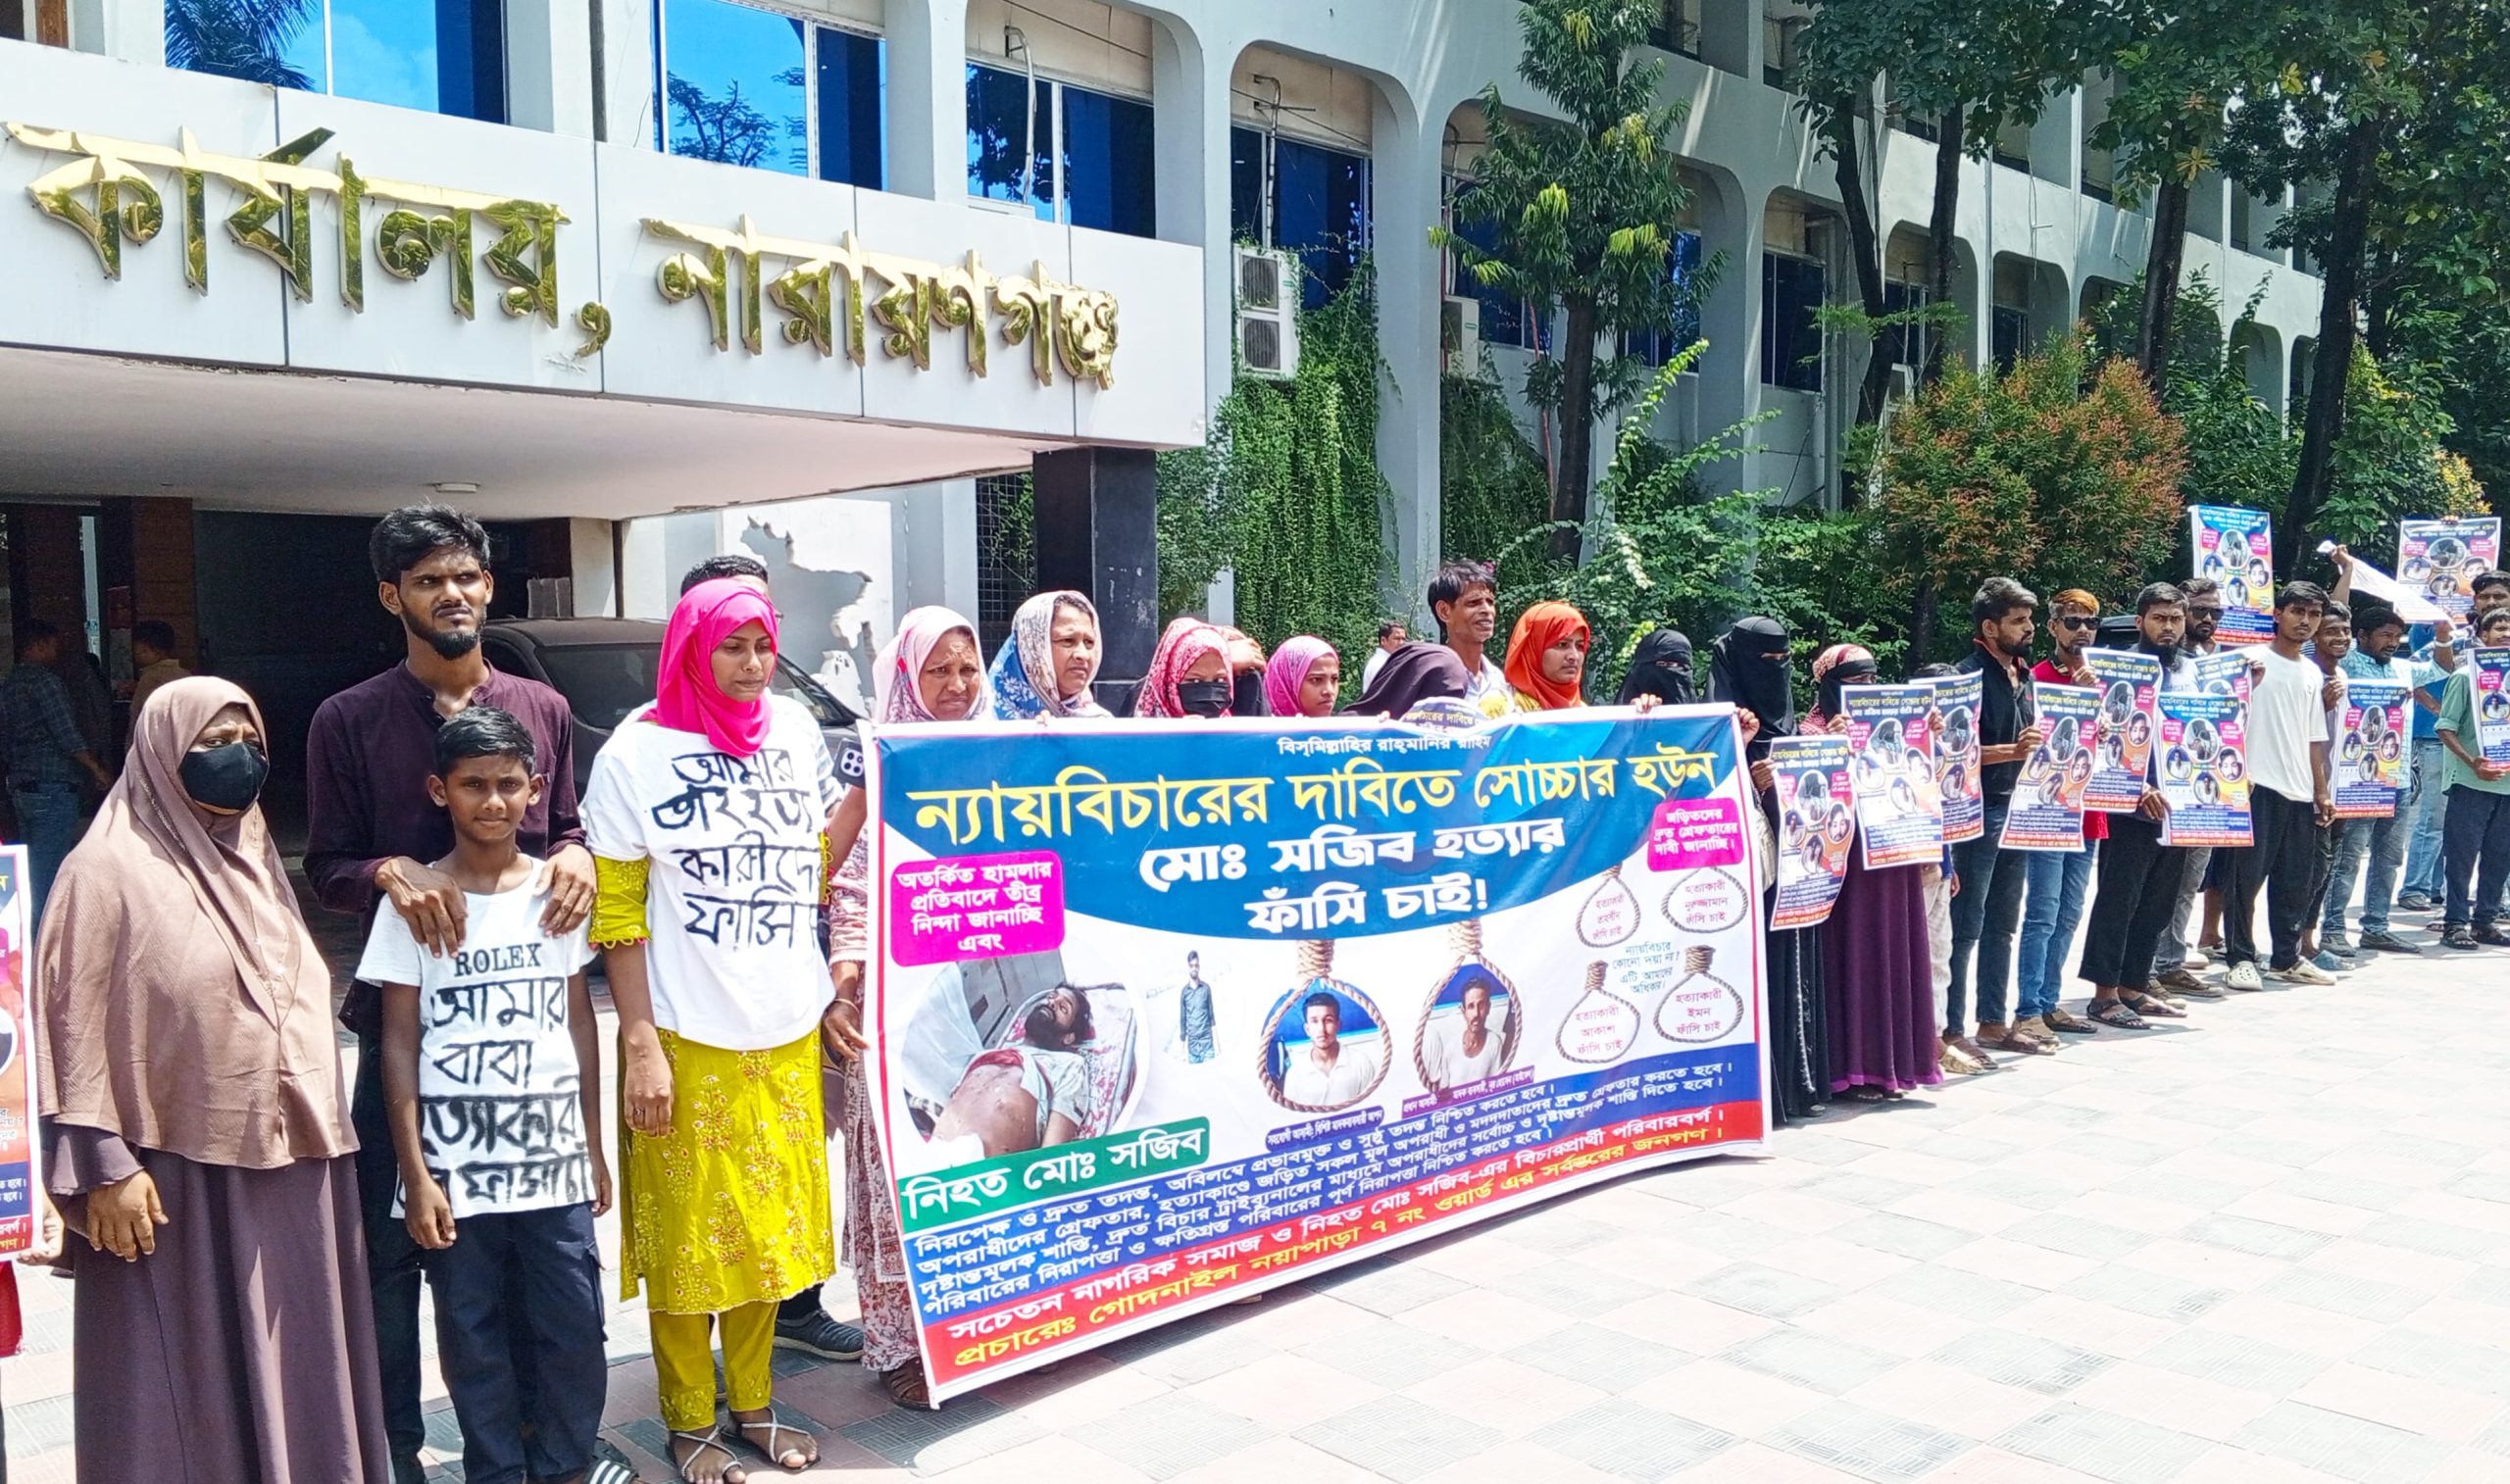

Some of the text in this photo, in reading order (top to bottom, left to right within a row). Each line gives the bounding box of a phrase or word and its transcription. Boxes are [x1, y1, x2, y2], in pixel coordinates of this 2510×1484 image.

[639, 213, 1119, 391] নারায়ণগঞ্জ
[907, 766, 1274, 846] ন্যায়বিচারের
[1286, 757, 1462, 819] দাবিতে
[1474, 755, 1618, 811] সোচ্চার
[1626, 743, 1718, 798] হউন
[1654, 827, 1675, 842] দ্রুত
[1665, 808, 1723, 824] জড়িতদের
[1139, 817, 1565, 892] মোঃ সজিব হত্যার
[1654, 839, 1680, 856] দাবী
[1682, 835, 1729, 853] জানাচ্ছি
[896, 862, 1053, 890] অতর্কিত হামলার
[910, 880, 1042, 913] প্রতিবাদে তীব্র
[911, 903, 1044, 935] নিন্দা জানাচ্ছি
[1244, 873, 1488, 933] ফাঁসি চাই!
[454, 943, 542, 976] ROLEX
[958, 934, 1004, 952] এবং
[430, 977, 566, 1031] আমার
[1675, 987, 1723, 1004] হত্যাকারী
[1685, 1006, 1711, 1017] ইমন
[1581, 1025, 1615, 1038] আকাশ
[1605, 1039, 1624, 1052] চাই
[1704, 1020, 1722, 1031] চাই
[433, 1039, 534, 1089] বাবা
[902, 1126, 1206, 1219] নিহত মোঃ সজিব
[914, 1217, 1012, 1257] নিরপেক্ষ
[1019, 1210, 1037, 1226] ও
[1043, 1199, 1092, 1223] দ্রুত
[1097, 1185, 1159, 1208] তদন্ত,
[1166, 1163, 1246, 1192] অবিলম্বে
[1250, 1142, 1332, 1173] প্রভাবমুক্ত
[1336, 1138, 1353, 1151] ও
[1387, 1118, 1428, 1137] তদন্ত
[1431, 1106, 1475, 1130] নিশ্চিত
[1480, 1095, 1516, 1113] করতে
[1521, 1084, 1545, 1102] হবে
[917, 1228, 1048, 1273] অপরাধীদের
[1255, 1163, 1311, 1189] জড়িত
[1317, 1152, 1358, 1172] সকল
[1363, 1144, 1389, 1163] মূল
[1393, 1125, 1450, 1151] অপরাধী
[1453, 1121, 1466, 1134] ও
[1470, 1097, 1551, 1128] মদদদাতাদের
[1555, 1090, 1587, 1108] দ্রুত
[1644, 1067, 1687, 1084] করতে
[1692, 1063, 1724, 1077] হবে
[919, 1252, 1036, 1300] দৃষ্টান্তমূলক
[1105, 1221, 1151, 1246] দ্রুত
[1157, 1206, 1212, 1232] বিচার
[1215, 1177, 1325, 1218] ট্রাইব্যুনালের
[1328, 1161, 1384, 1187] মাধ্যমে
[1387, 1134, 1468, 1168] অপরাধীদের
[1472, 1120, 1516, 1143] সর্বোচ্চ
[1521, 1116, 1532, 1128] ও
[1642, 1082, 1678, 1099] দিতে
[1682, 1077, 1713, 1092] হবে
[923, 1273, 1031, 1315] পরিবারের
[1036, 1247, 1121, 1284] নিরাপত্তা
[1128, 1241, 1146, 1256] ও
[1238, 1194, 1323, 1225] পরিবারের
[1328, 1184, 1353, 1206] পূর্ণ
[1359, 1166, 1419, 1195] নিরাপত্তা
[1423, 1151, 1468, 1176] নিশ্চিত
[1472, 1137, 1510, 1158] করতে
[1515, 1129, 1542, 1146] হবে
[947, 1293, 1065, 1338] সচেতন
[1072, 1258, 1179, 1302] নাগরিক
[1184, 1235, 1263, 1266] সমাজ
[1271, 1227, 1292, 1242] ও
[1300, 1205, 1365, 1237] নিহত
[1371, 1191, 1411, 1215] মোঃ
[1612, 1107, 1713, 1139] পরিবারবর্গ
[954, 1316, 1077, 1366] প্রচারেঃ
[1088, 1262, 1241, 1323] গোদনাইল
[1248, 1226, 1362, 1270] নয়াপাড়া
[1371, 1220, 1387, 1233] ৭
[1395, 1207, 1427, 1225] নং
[1434, 1178, 1495, 1212] ওয়ার্ড
[1500, 1169, 1534, 1192] এর
[1540, 1144, 1626, 1178] সর্বস্তরের
[1632, 1128, 1709, 1151] জনগণ
